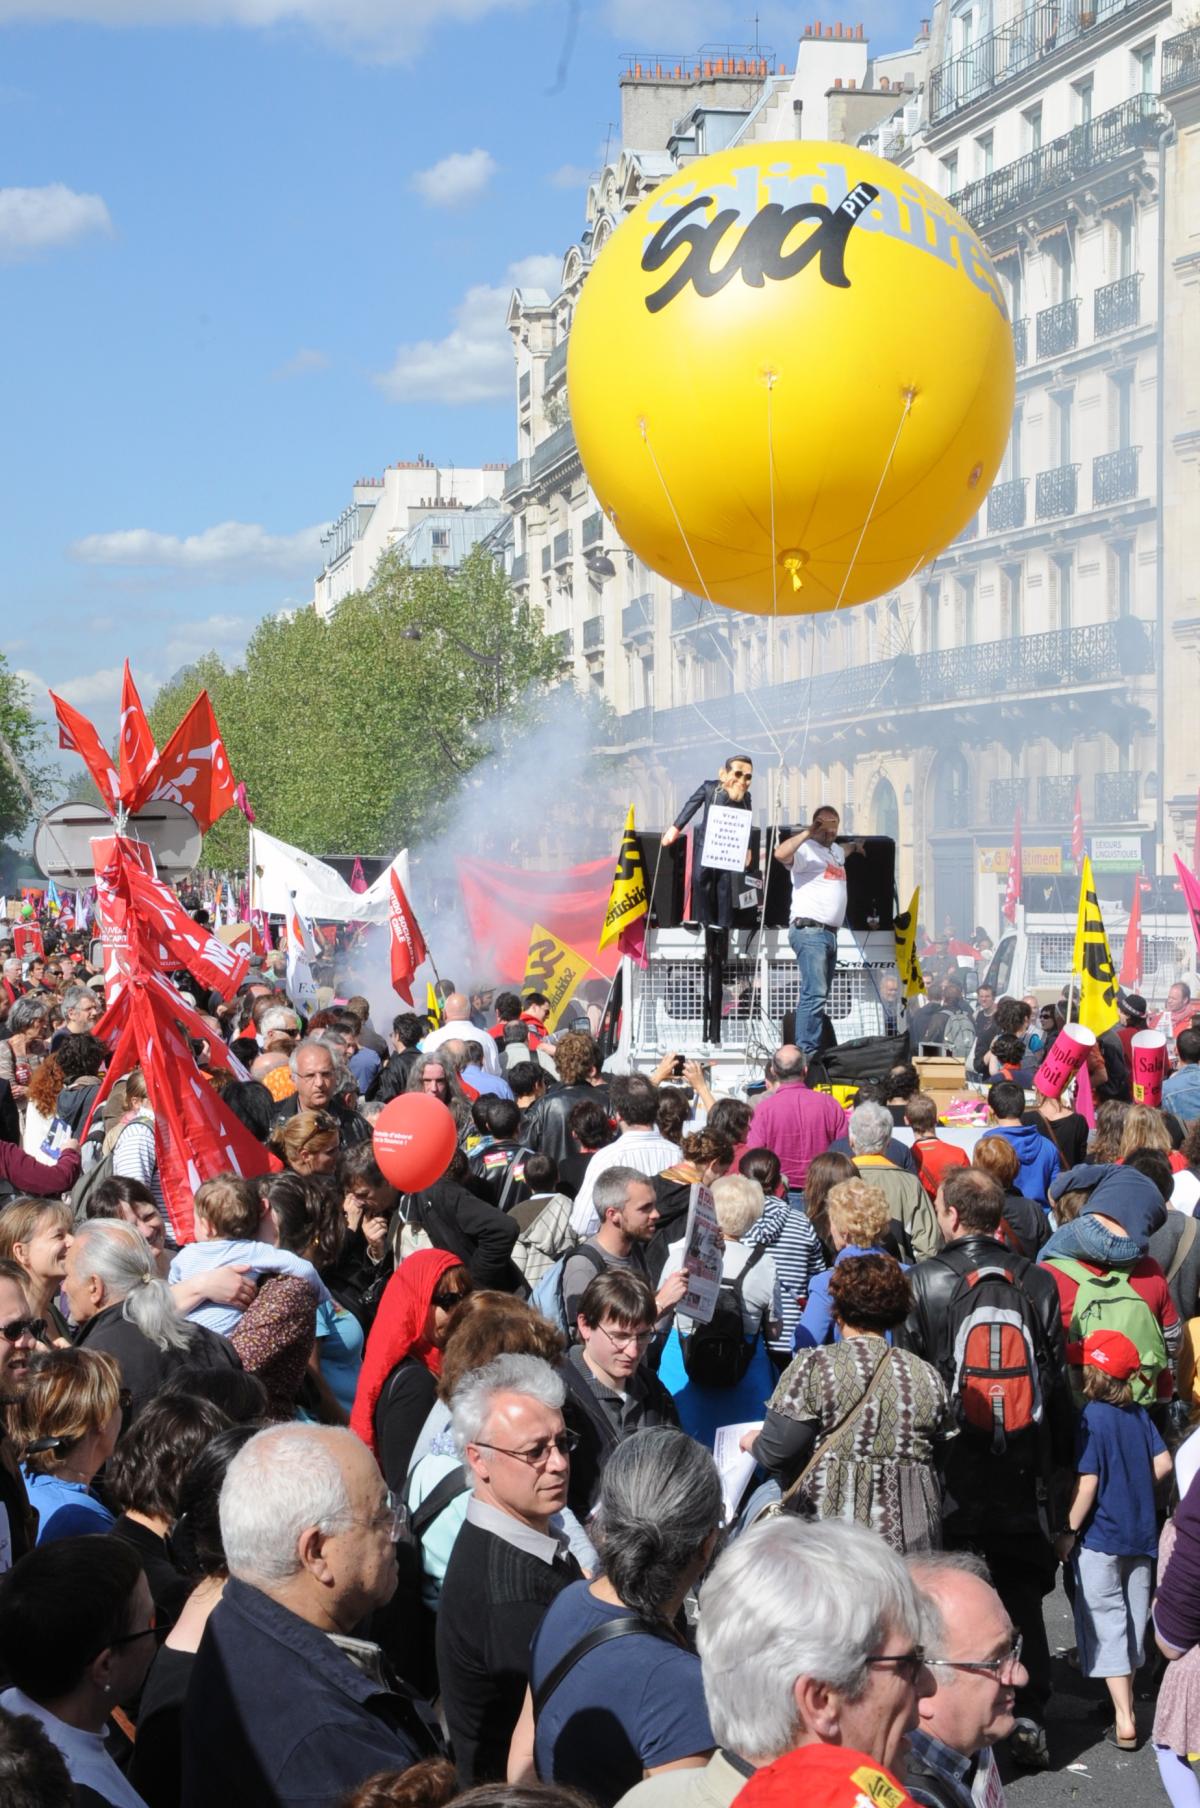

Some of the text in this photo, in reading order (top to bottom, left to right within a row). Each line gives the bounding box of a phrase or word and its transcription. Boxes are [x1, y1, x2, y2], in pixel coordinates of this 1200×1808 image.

[841, 184, 874, 219] PTT
[1022, 850, 1060, 867] âtiment
[836, 960, 896, 969] SPRINTER
